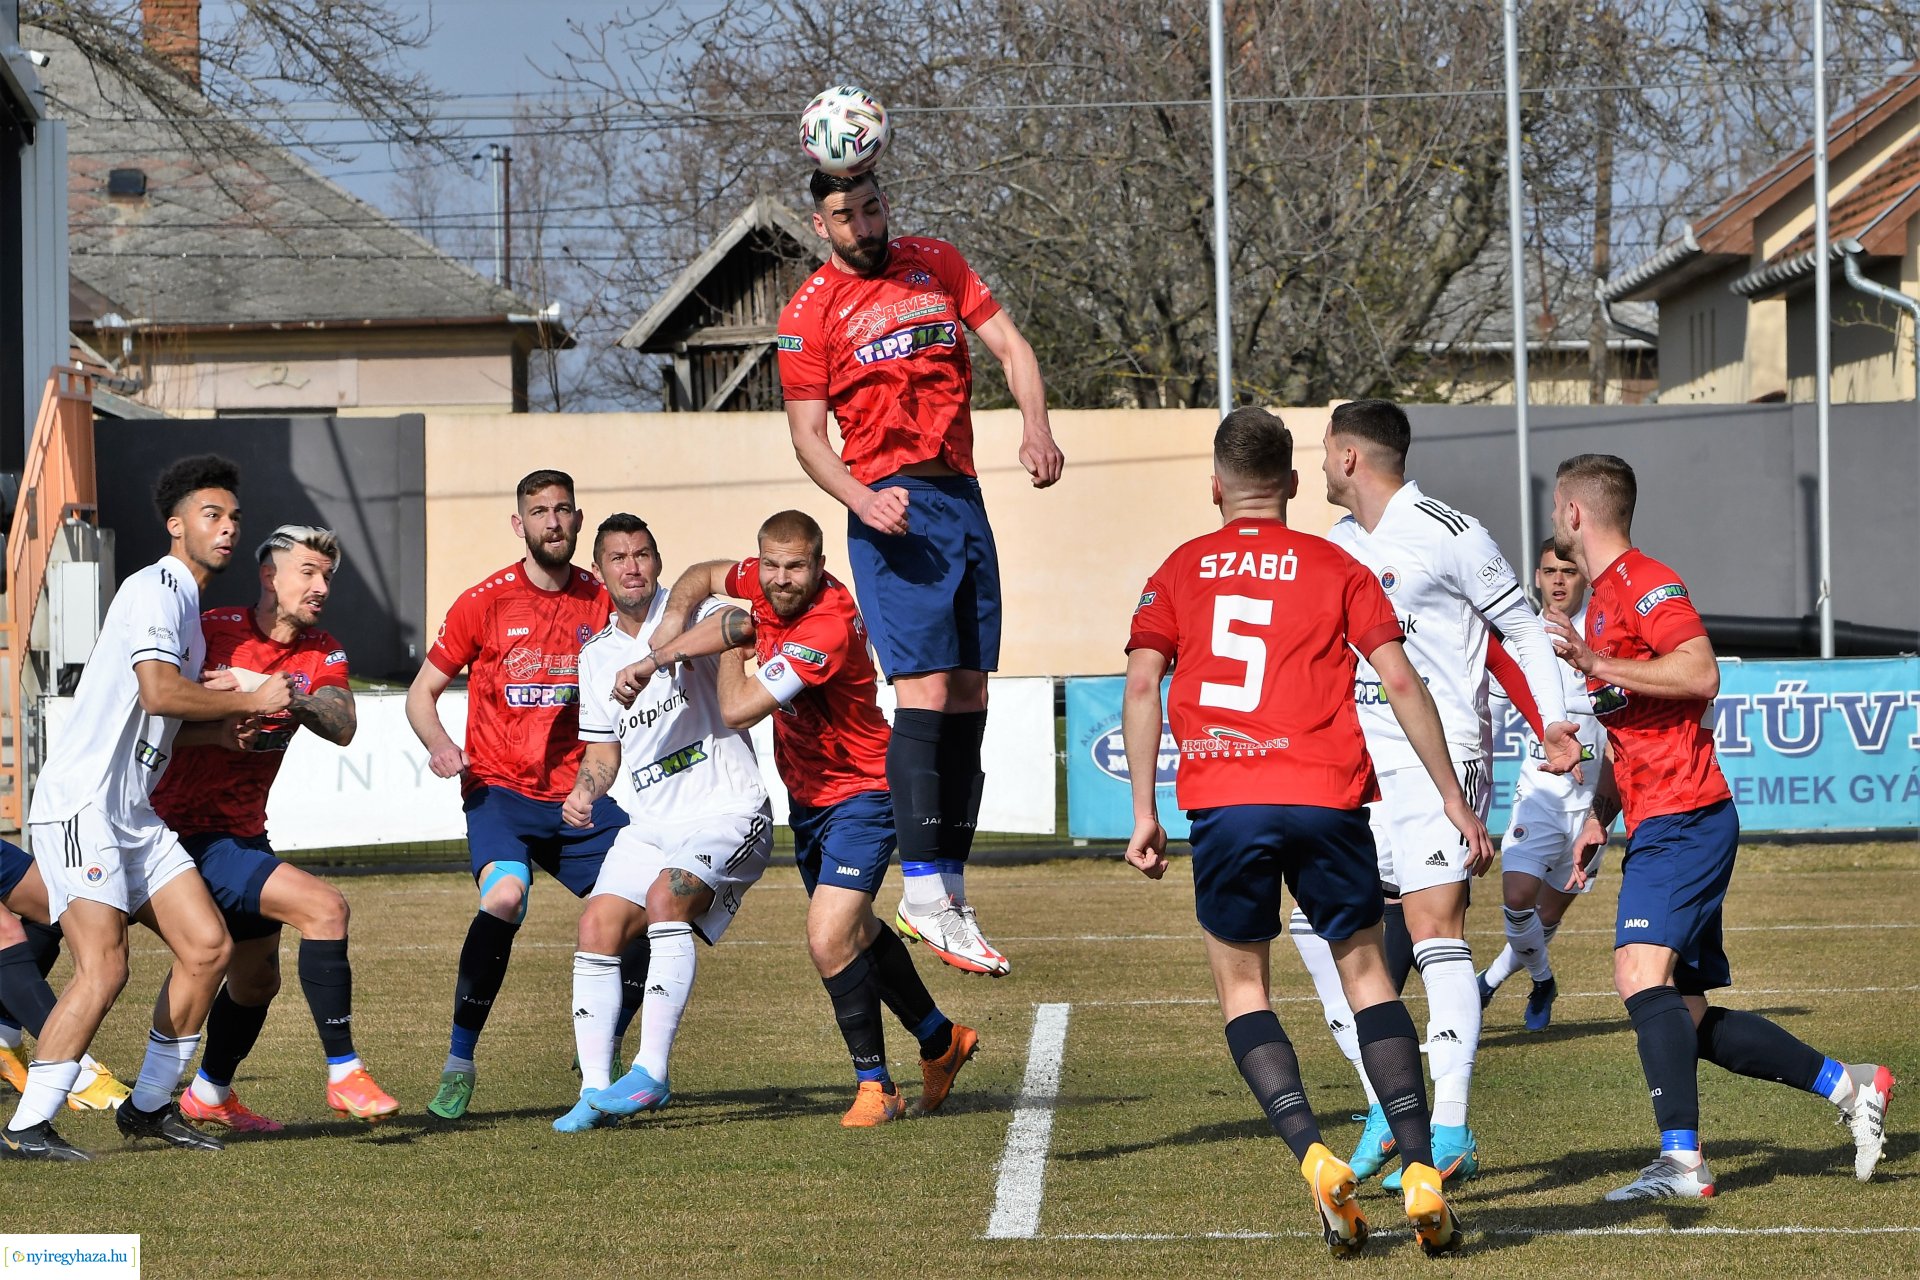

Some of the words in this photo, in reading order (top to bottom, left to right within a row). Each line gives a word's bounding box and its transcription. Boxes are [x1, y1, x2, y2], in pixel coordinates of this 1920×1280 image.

[838, 301, 858, 319] JAK
[1199, 548, 1298, 581] SZABÓ
[507, 627, 529, 637] JAKO
[1198, 594, 1274, 713] 5
[1713, 680, 1920, 756] ŰV
[1233, 737, 1290, 750] TRANS
[1187, 750, 1267, 760] HUNGARY
[836, 865, 860, 877] JAKO
[1624, 918, 1649, 928] JAKO
